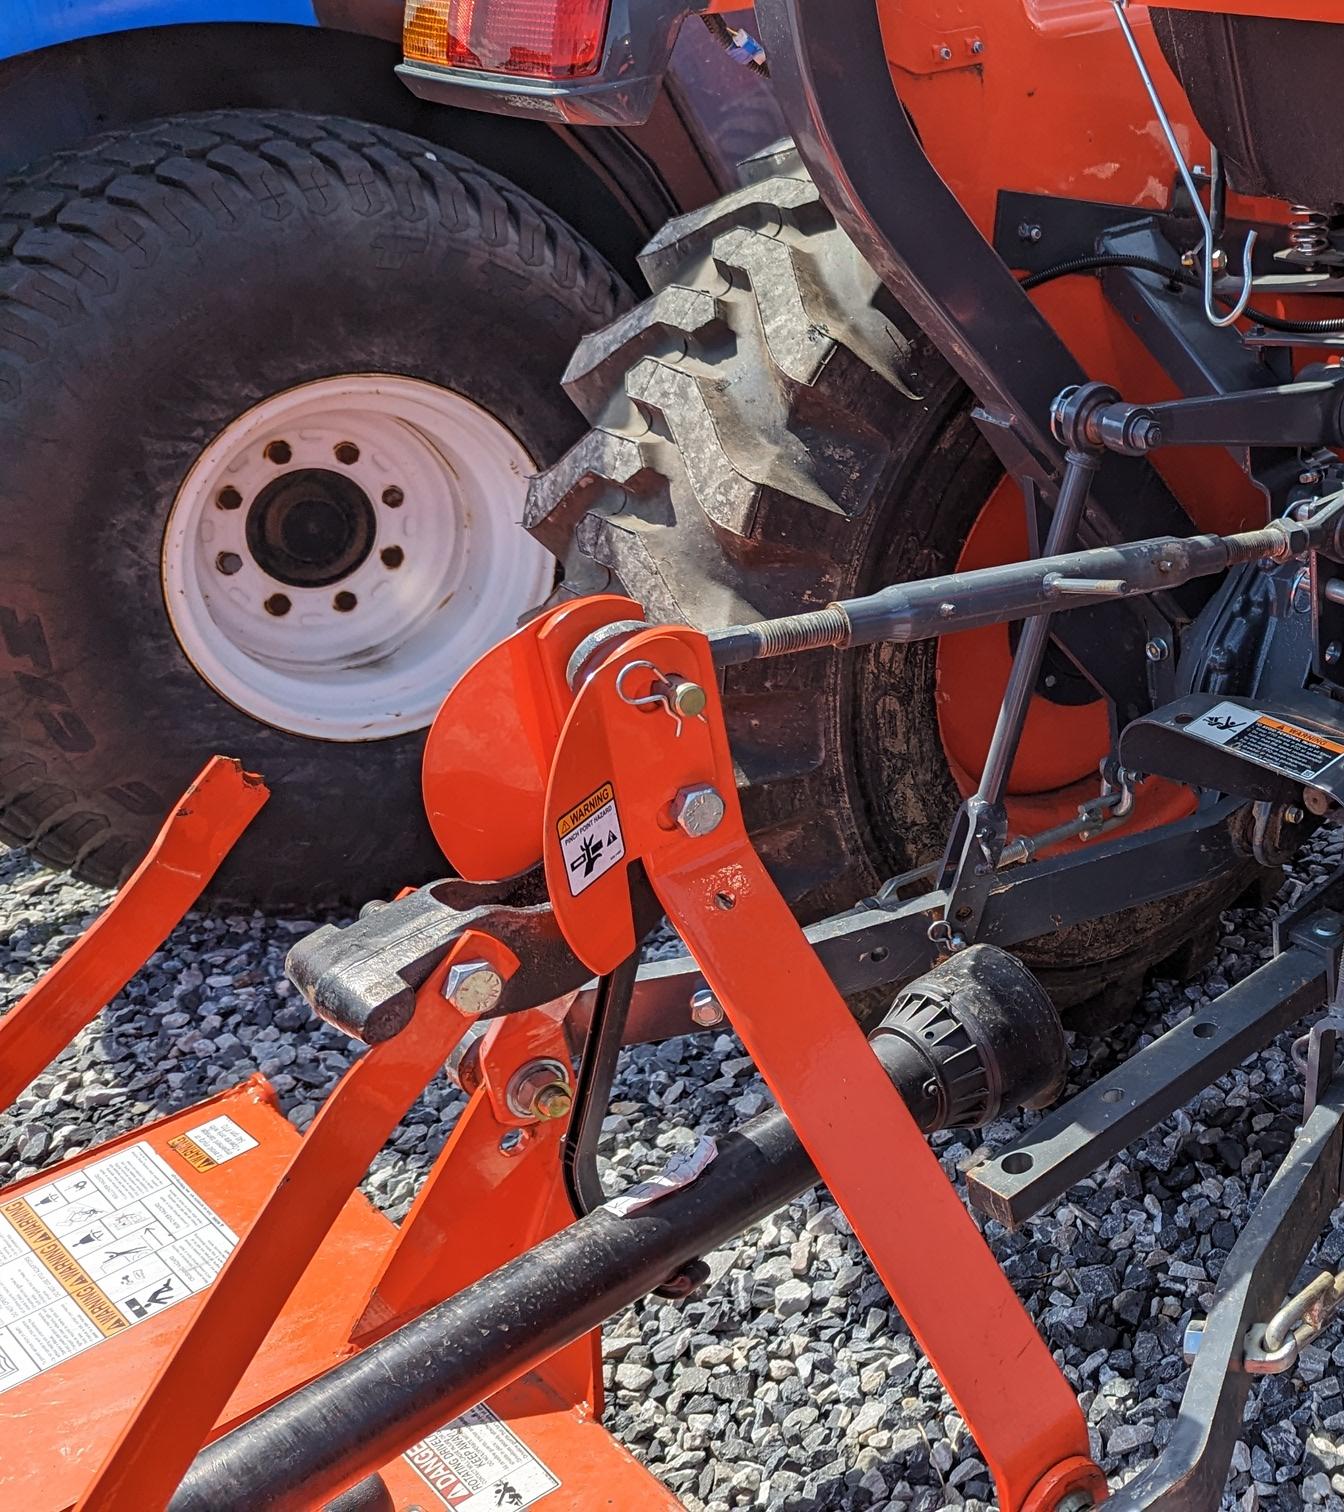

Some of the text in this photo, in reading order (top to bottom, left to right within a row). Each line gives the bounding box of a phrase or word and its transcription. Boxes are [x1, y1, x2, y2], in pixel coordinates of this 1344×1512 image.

[1288, 728, 1327, 745] WARNING
[564, 804, 612, 846] PINCH POINT HAZARD
[570, 786, 609, 826] WARNING
[170, 1136, 207, 1164] WARNING
[2, 1200, 46, 1238] WARNING
[38, 1242, 82, 1282] WARNING
[74, 1284, 119, 1325] WARNING
[403, 1440, 459, 1490] DANGE
[424, 1432, 455, 1460] DRIVEL
[462, 1447, 486, 1469] KEEP
[446, 1456, 483, 1491] ROTATING
